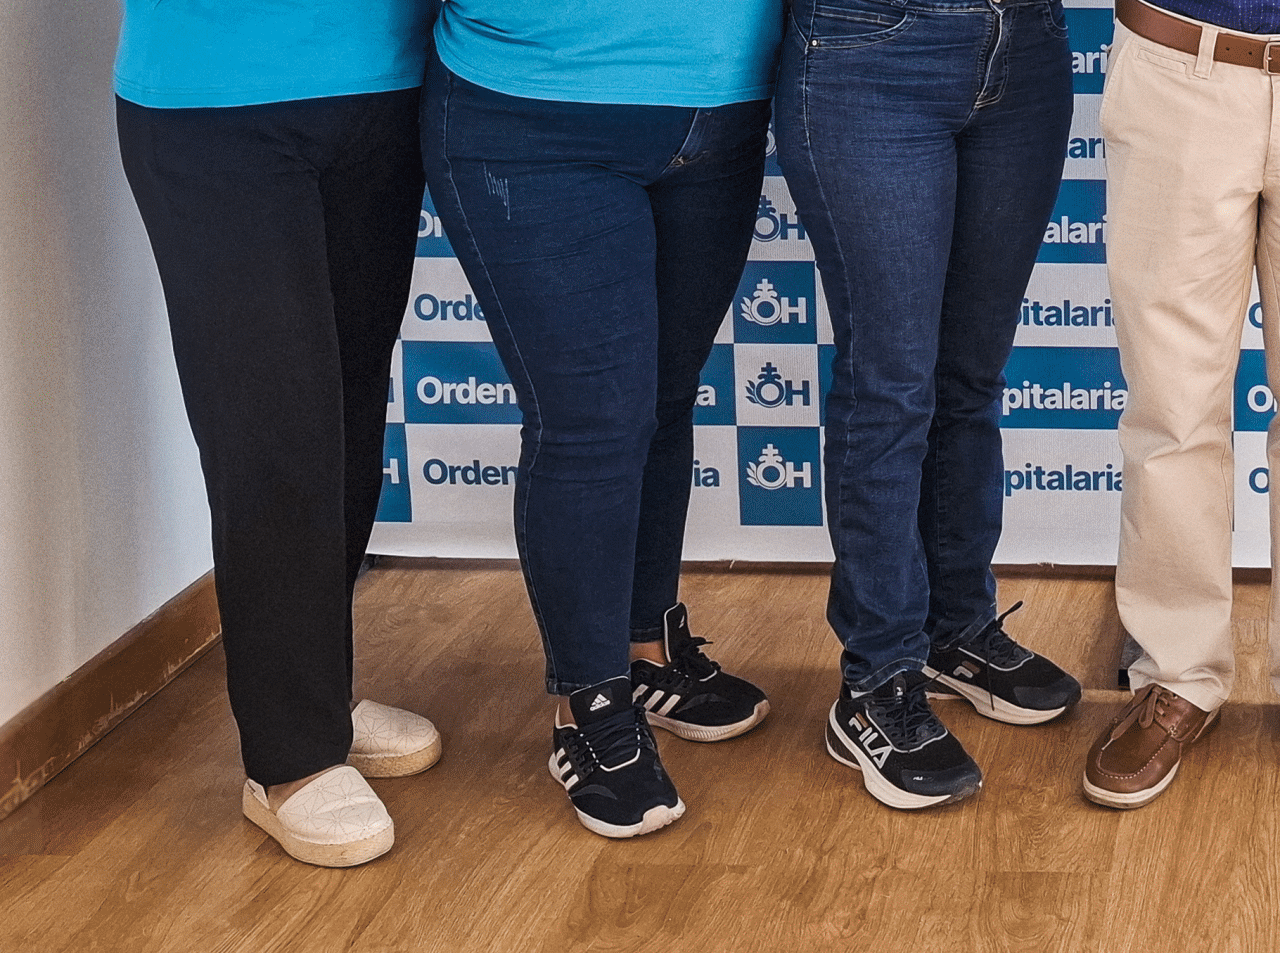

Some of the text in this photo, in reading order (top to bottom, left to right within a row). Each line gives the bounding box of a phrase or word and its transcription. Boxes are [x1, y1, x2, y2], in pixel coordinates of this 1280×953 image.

[414, 293, 486, 321] Orde
[416, 376, 517, 404] Orden
[1002, 381, 1128, 415] pitalaria
[423, 458, 519, 485] Orden
[1003, 464, 1123, 496] pitalaria
[848, 712, 893, 769] FILA
